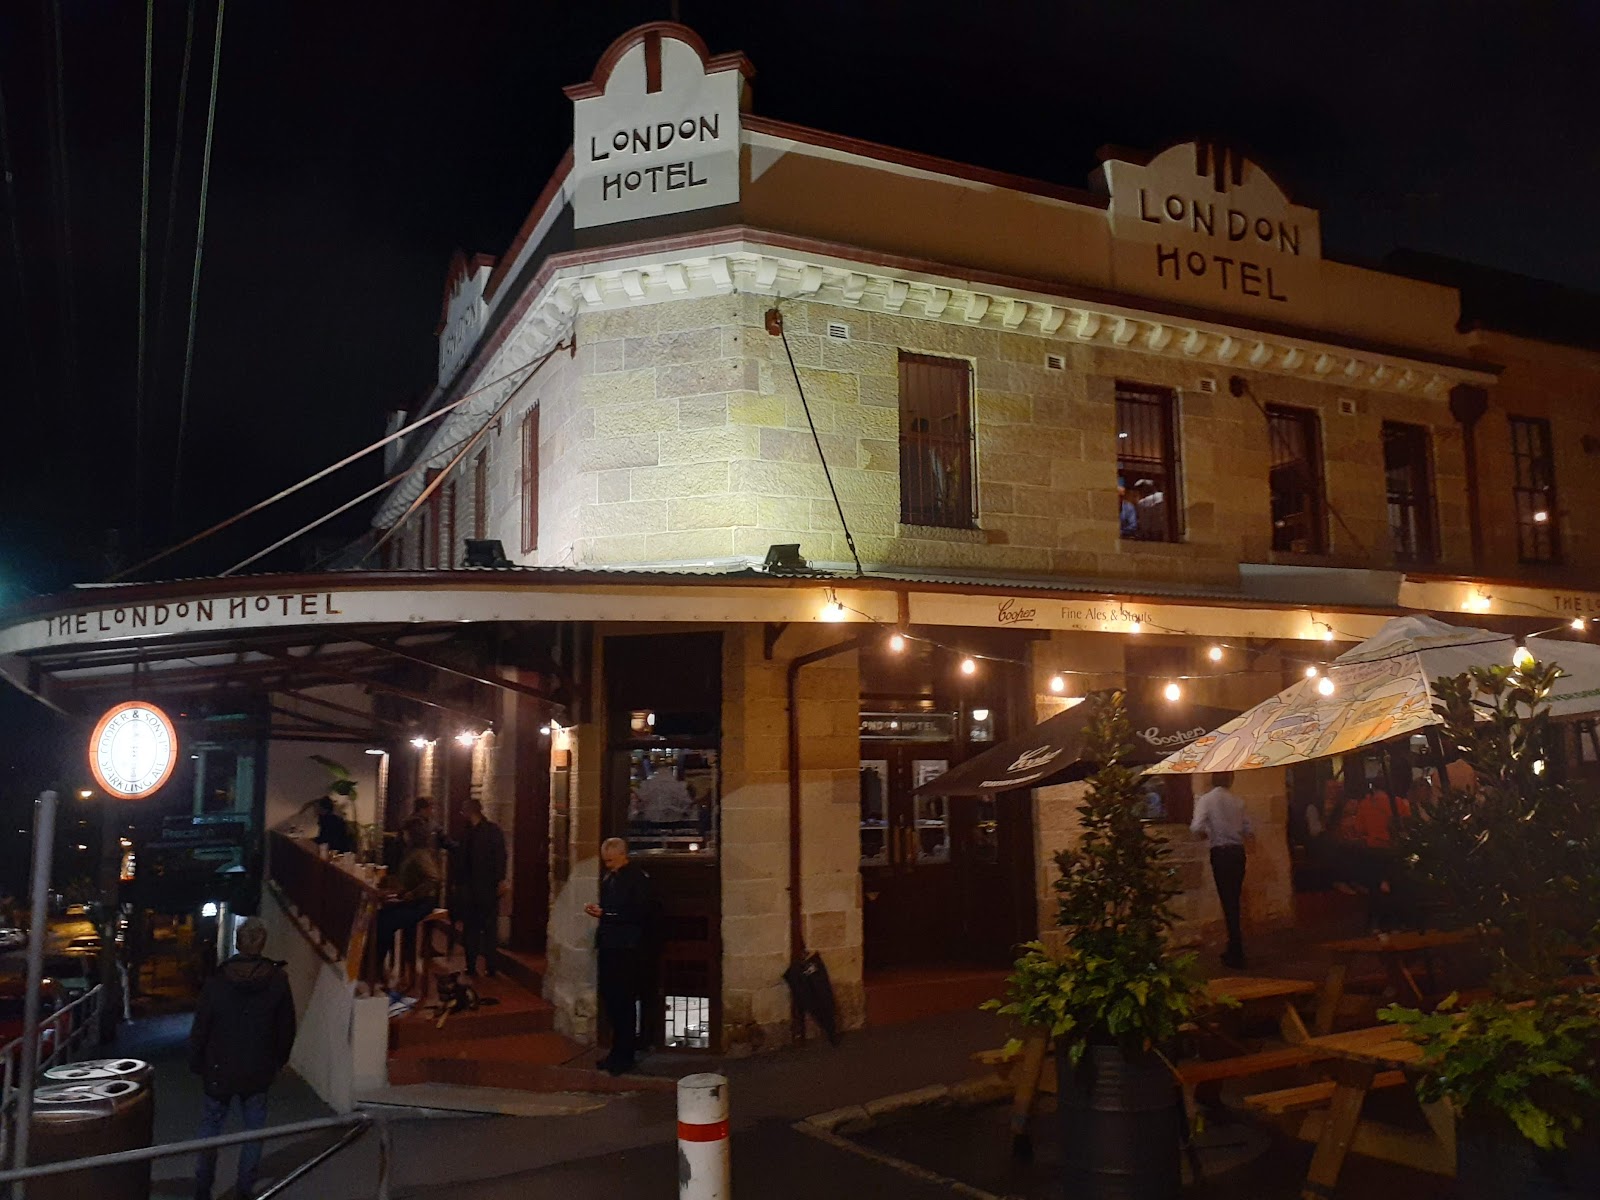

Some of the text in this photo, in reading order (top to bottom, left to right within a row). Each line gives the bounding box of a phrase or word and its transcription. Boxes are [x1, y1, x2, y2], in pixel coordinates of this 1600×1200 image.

[591, 113, 719, 162] LONDON
[603, 161, 708, 201] HOTEL
[1138, 188, 1300, 256] LONDON
[1156, 243, 1288, 302] HOTEL
[46, 594, 343, 636] THE LONDON HOTEL
[998, 598, 1036, 625] Coopers
[1061, 606, 1082, 620] Fine
[1086, 608, 1107, 621] Ales
[1110, 609, 1118, 621] &
[1554, 595, 1582, 611] THE
[101, 713, 129, 754] COOPER
[132, 709, 140, 719] &
[1136, 726, 1207, 748] Coopers
